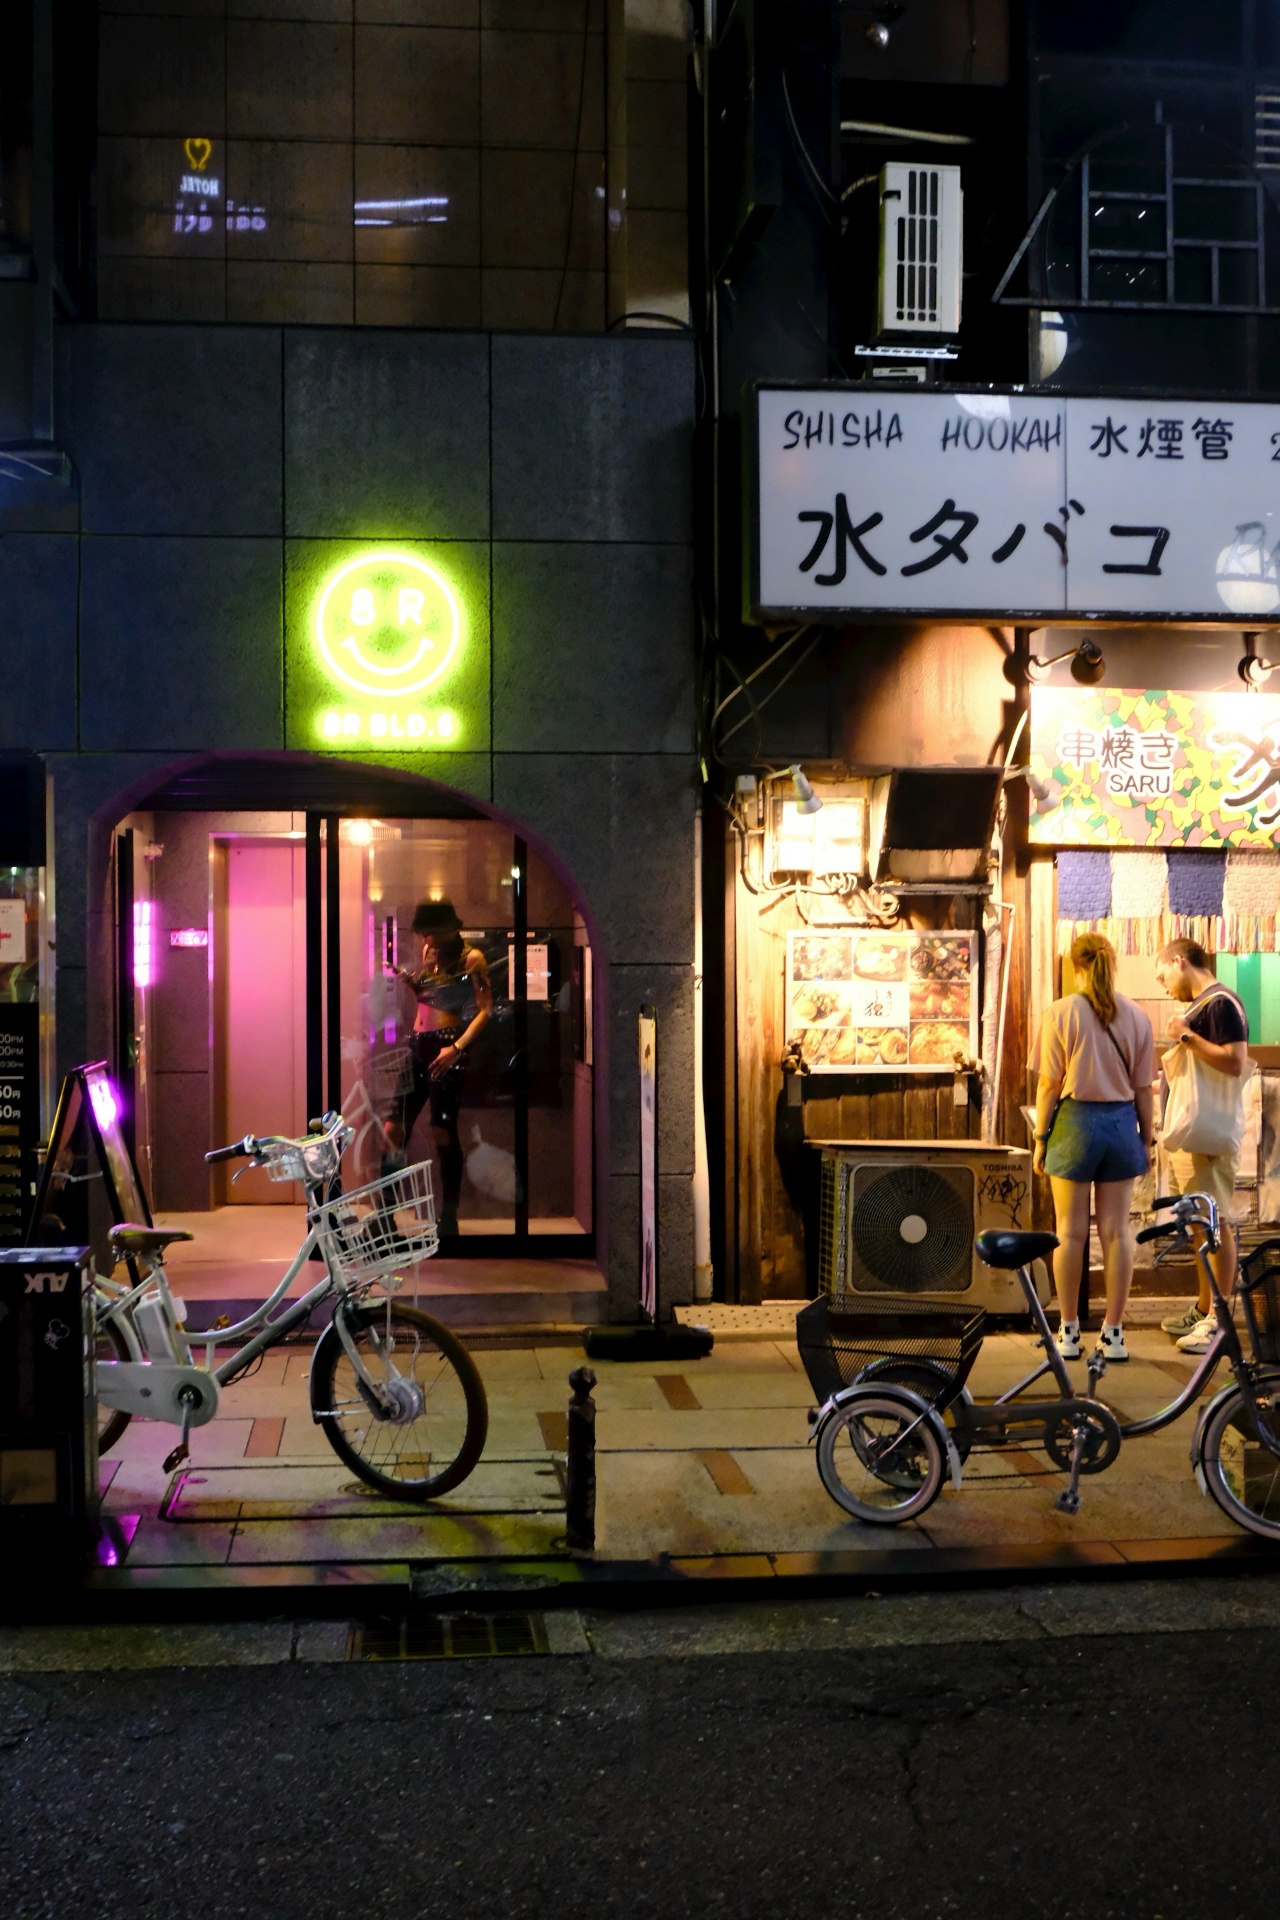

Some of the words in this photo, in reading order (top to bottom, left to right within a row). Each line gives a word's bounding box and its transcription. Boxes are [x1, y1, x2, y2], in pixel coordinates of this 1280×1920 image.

[783, 409, 903, 449] SHISHA
[942, 413, 1061, 453] HOOKAH
[1090, 416, 1234, 460] 水煙管
[797, 492, 1170, 586] 水タバコ
[1062, 729, 1175, 770] 串焼き
[1110, 774, 1170, 794] SARU
[983, 1163, 1023, 1172] TOSHIBA
